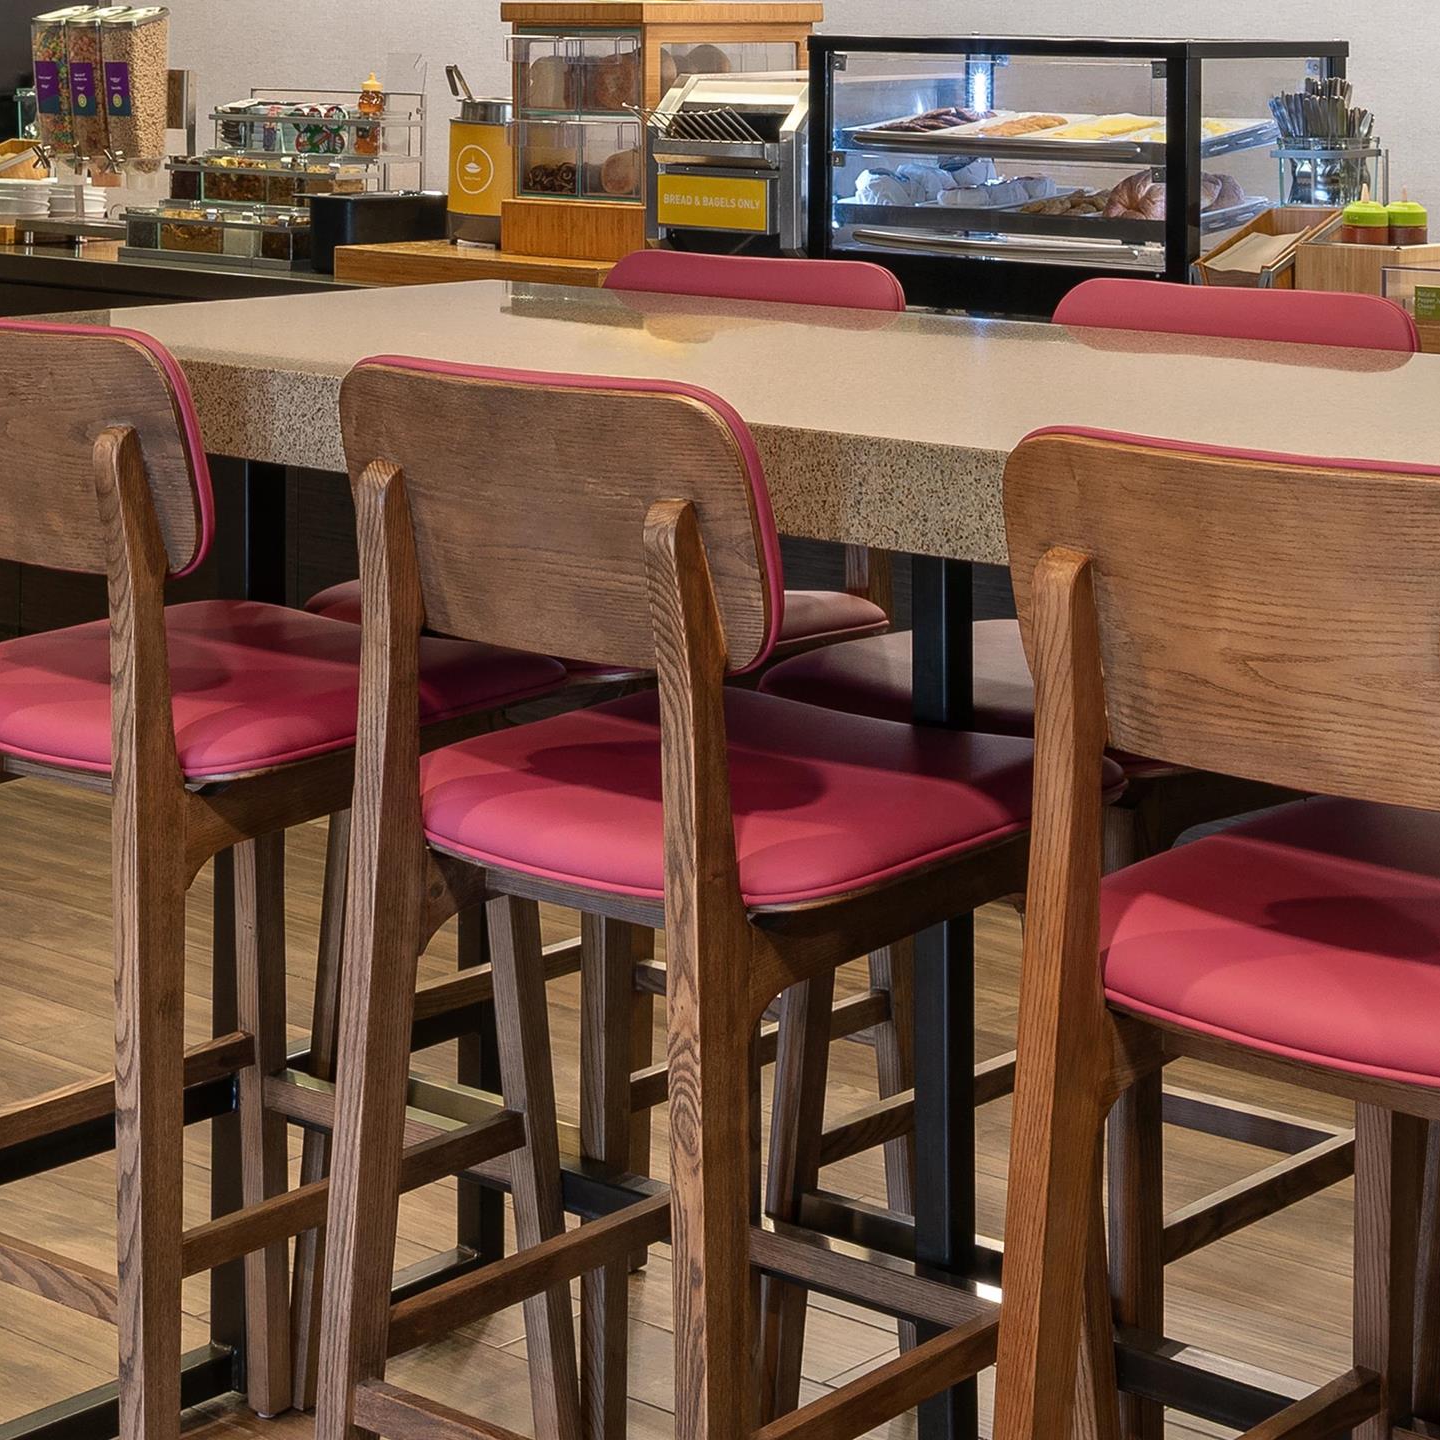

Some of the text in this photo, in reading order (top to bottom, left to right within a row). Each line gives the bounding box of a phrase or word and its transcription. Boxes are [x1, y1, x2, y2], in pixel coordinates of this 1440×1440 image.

[663, 193, 761, 210] BREAD & BAGELS ONLY
